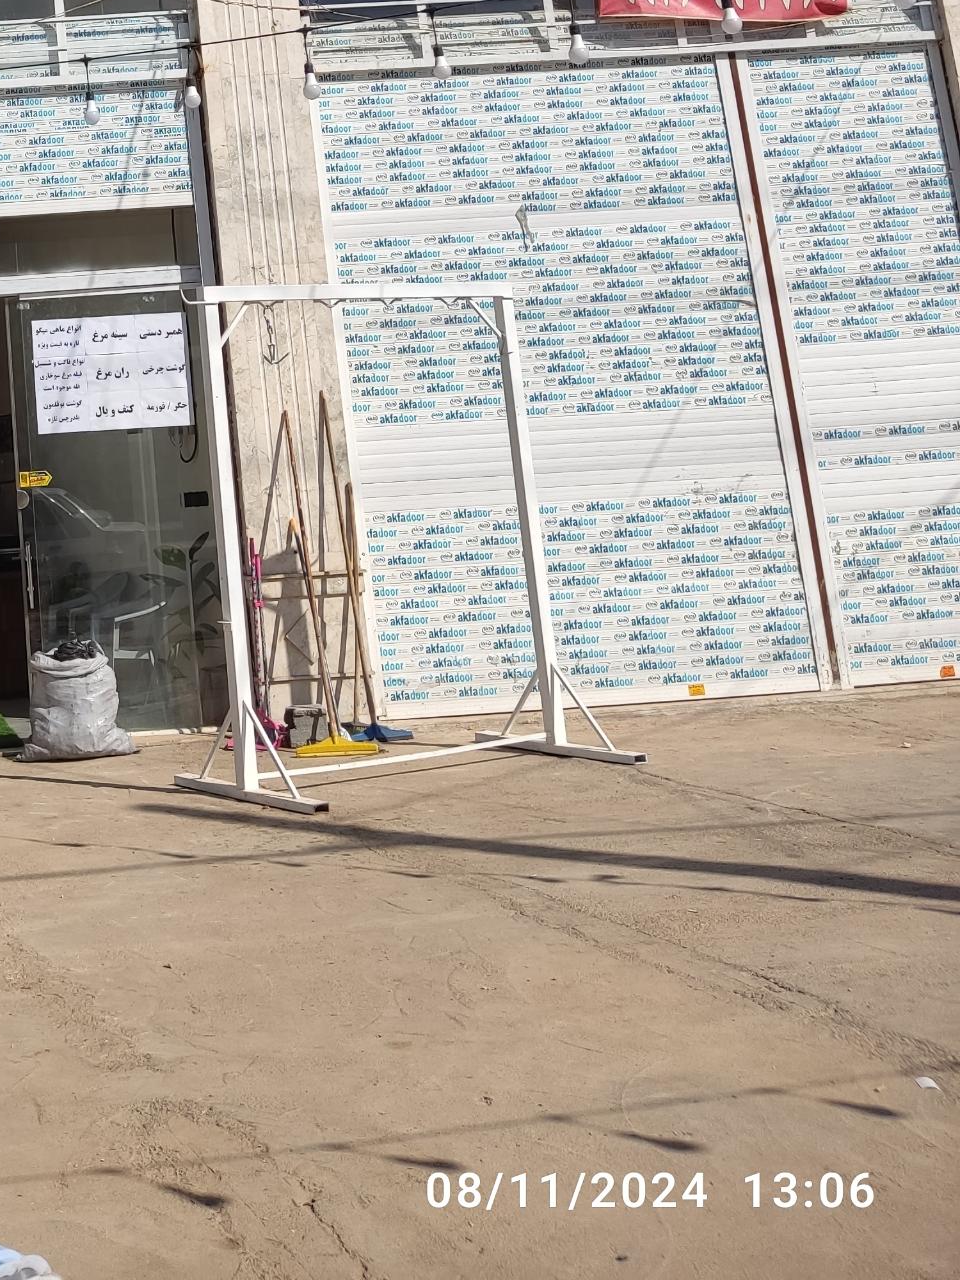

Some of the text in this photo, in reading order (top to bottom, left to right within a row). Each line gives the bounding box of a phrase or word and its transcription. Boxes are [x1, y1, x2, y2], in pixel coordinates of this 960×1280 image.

[371, 69, 657, 93] akfadoor akfadoor akfadoor akfadoor akfadoor
[763, 62, 923, 81] akfadoor akfadoor akfadoor
[38, 148, 74, 158] akfadoor
[101, 144, 137, 155] akfadoor
[764, 140, 924, 158] akfadoor akfadoor akfadoor
[331, 184, 684, 212] akfadoor akfadoor akfadoor akfadoor akfadoor akfadoor
[92, 329, 128, 342] سینه مرغ
[96, 367, 130, 380] ران مرغ
[824, 424, 925, 440] akfadoor akfadoor
[586, 493, 756, 512] akfadoor akfadoor akfadoor
[547, 519, 786, 542] akfadoor akfadoor akfadoor akfadoor
[563, 607, 804, 630] akfadoor akfadoor akfadoor akfadoor
[595, 668, 768, 689] akfadoor akfadoor akfadoor
[390, 687, 496, 701] akfadoor akfadoor
